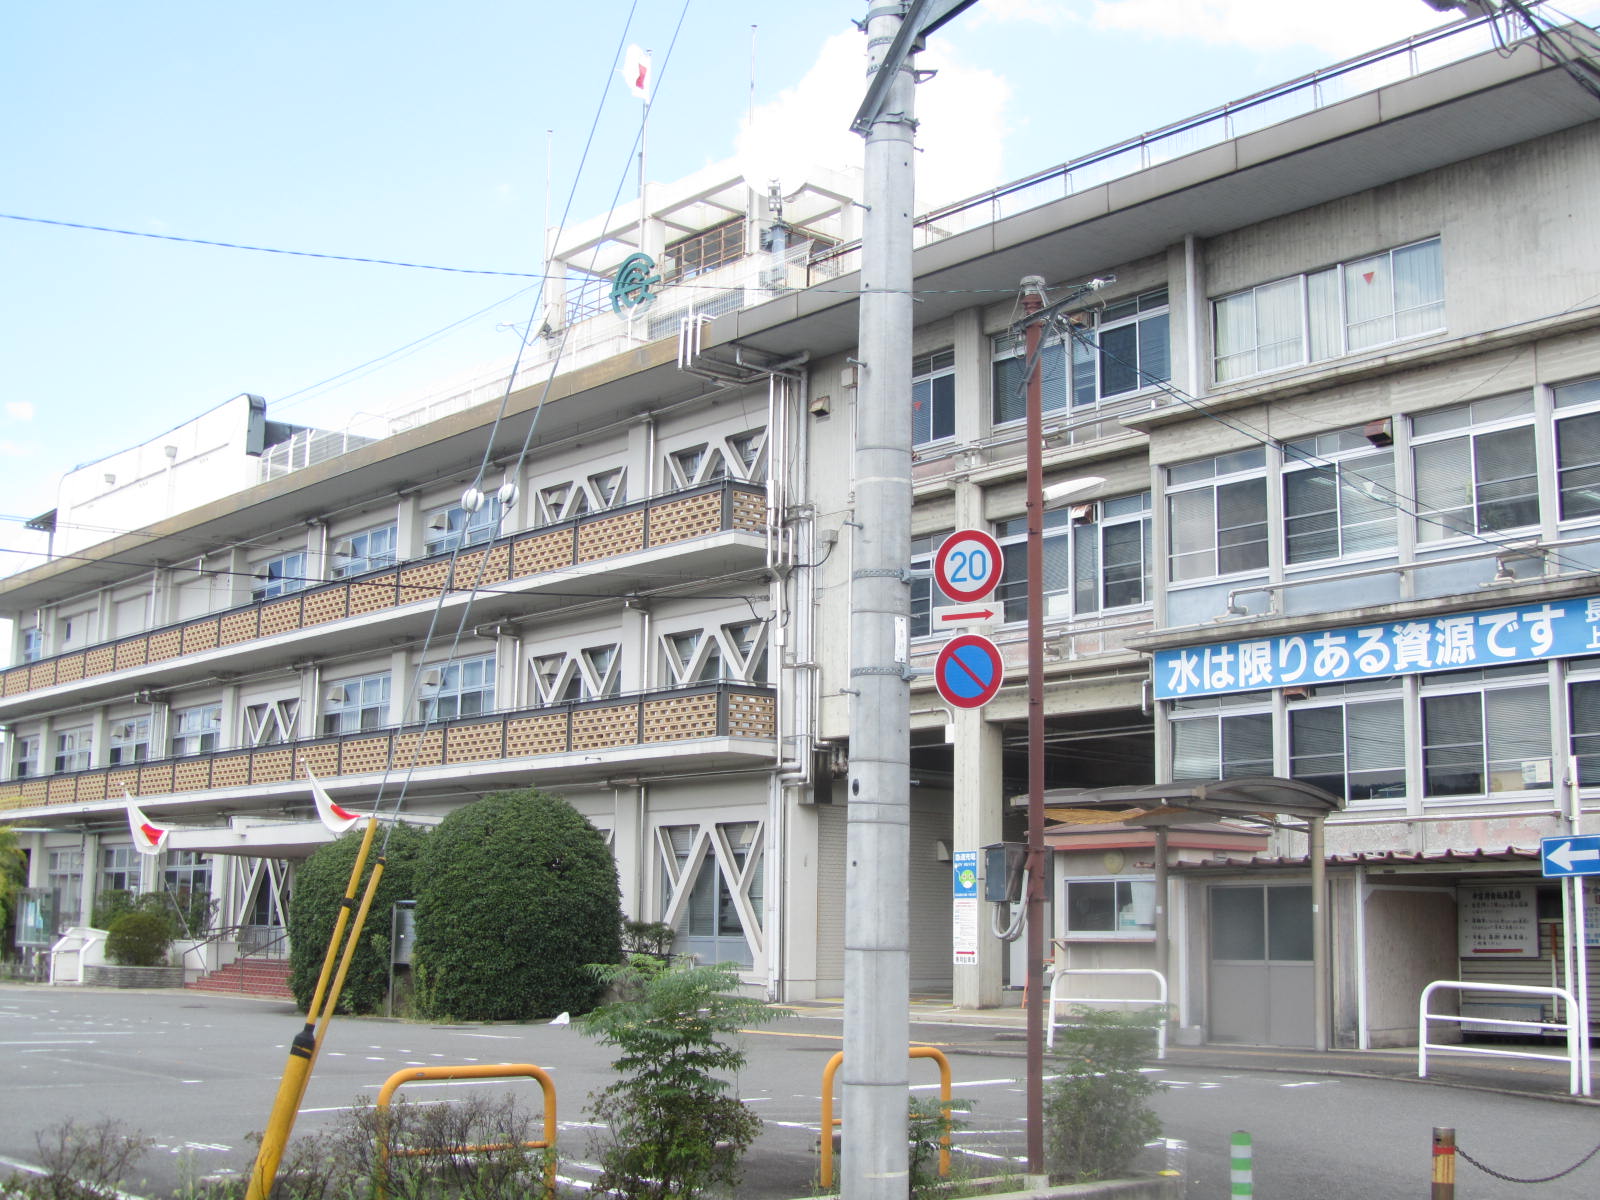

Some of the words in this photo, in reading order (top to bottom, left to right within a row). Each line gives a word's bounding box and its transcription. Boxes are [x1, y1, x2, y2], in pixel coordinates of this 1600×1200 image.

[950, 549, 987, 583] 20
[1167, 604, 1566, 694] 水は限りある資源です
